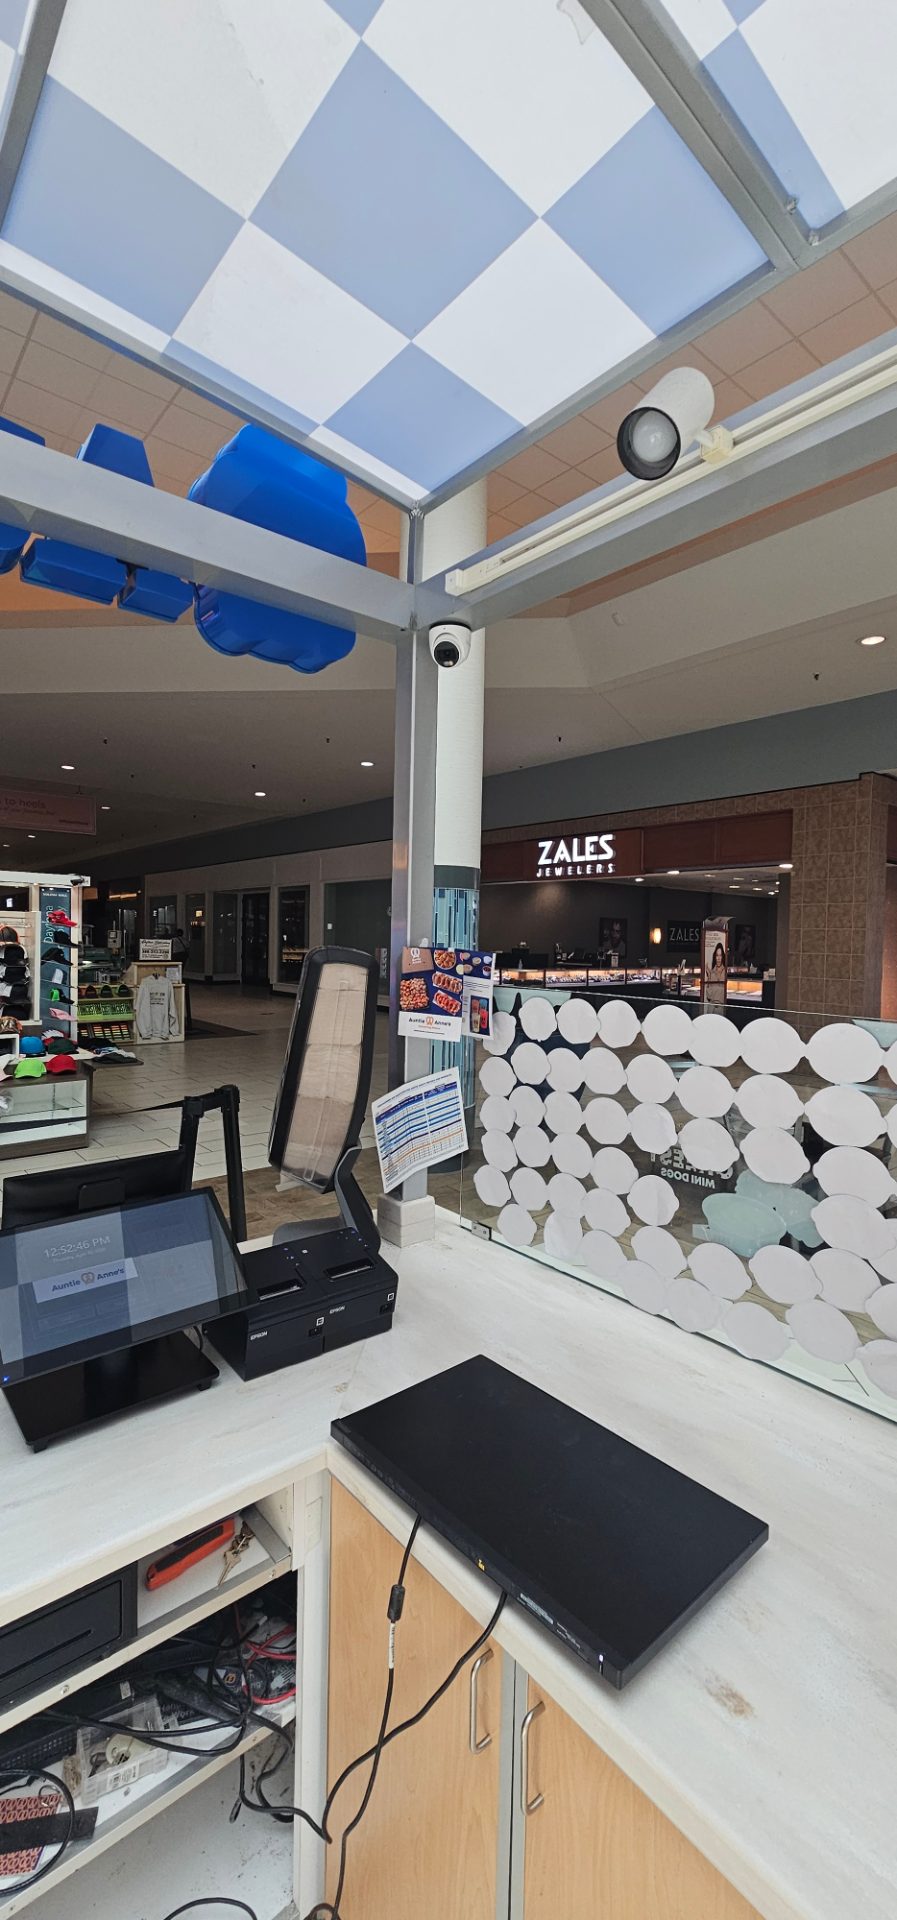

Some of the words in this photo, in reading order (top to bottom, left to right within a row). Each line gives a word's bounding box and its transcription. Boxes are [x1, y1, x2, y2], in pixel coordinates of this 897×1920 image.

[537, 834, 614, 865] ZALES
[536, 863, 614, 878] JEWELERS
[669, 927, 700, 942] ZALES
[44, 1240, 91, 1258] 12:52:46
[93, 1236, 111, 1248] PM
[52, 1279, 81, 1292] Auntie
[97, 1267, 125, 1281] Anne's
